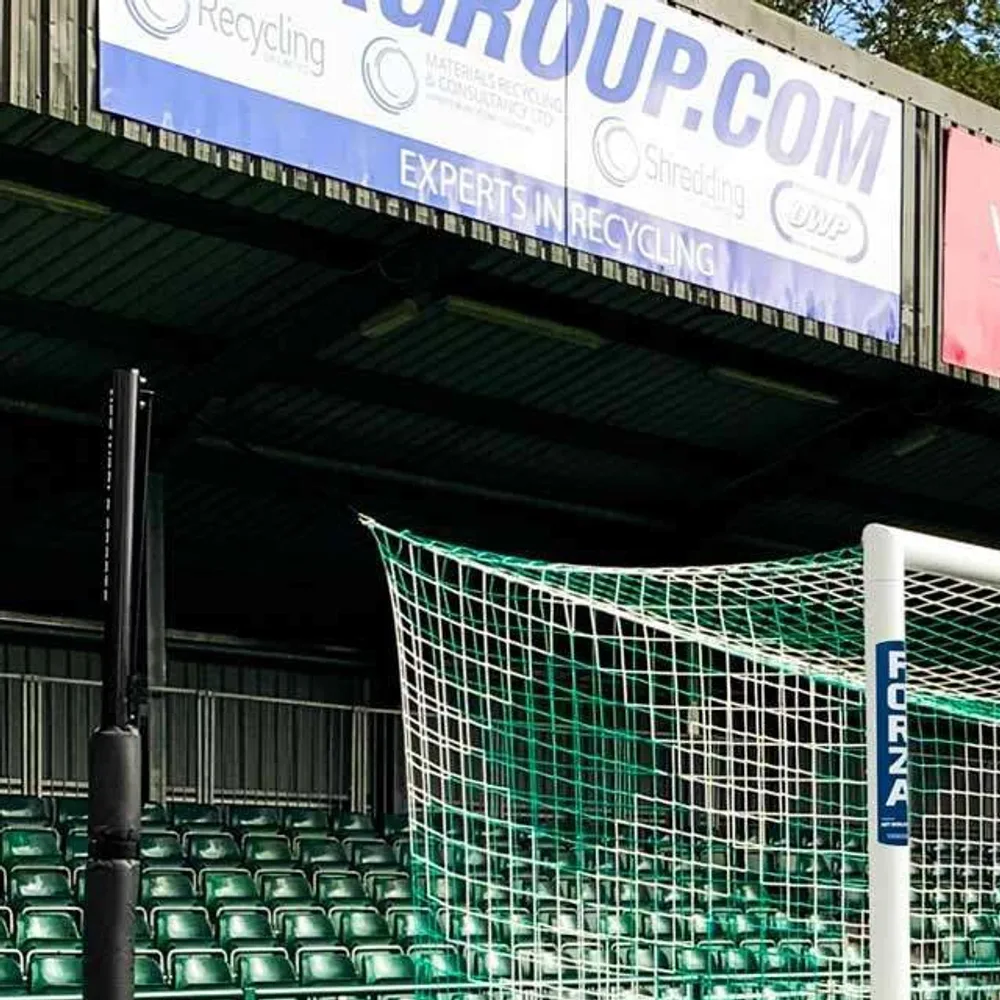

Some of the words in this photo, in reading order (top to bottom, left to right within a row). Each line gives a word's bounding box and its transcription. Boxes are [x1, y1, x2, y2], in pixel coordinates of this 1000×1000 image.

[198, 0, 325, 77] Recycling
[425, 52, 497, 90] MATERIALS
[340, 0, 891, 197] ROUP.COM
[400, 148, 527, 222] EXPERTS
[534, 191, 564, 232] IN
[570, 203, 715, 277] RECYCLING
[644, 143, 746, 220] Shredding
